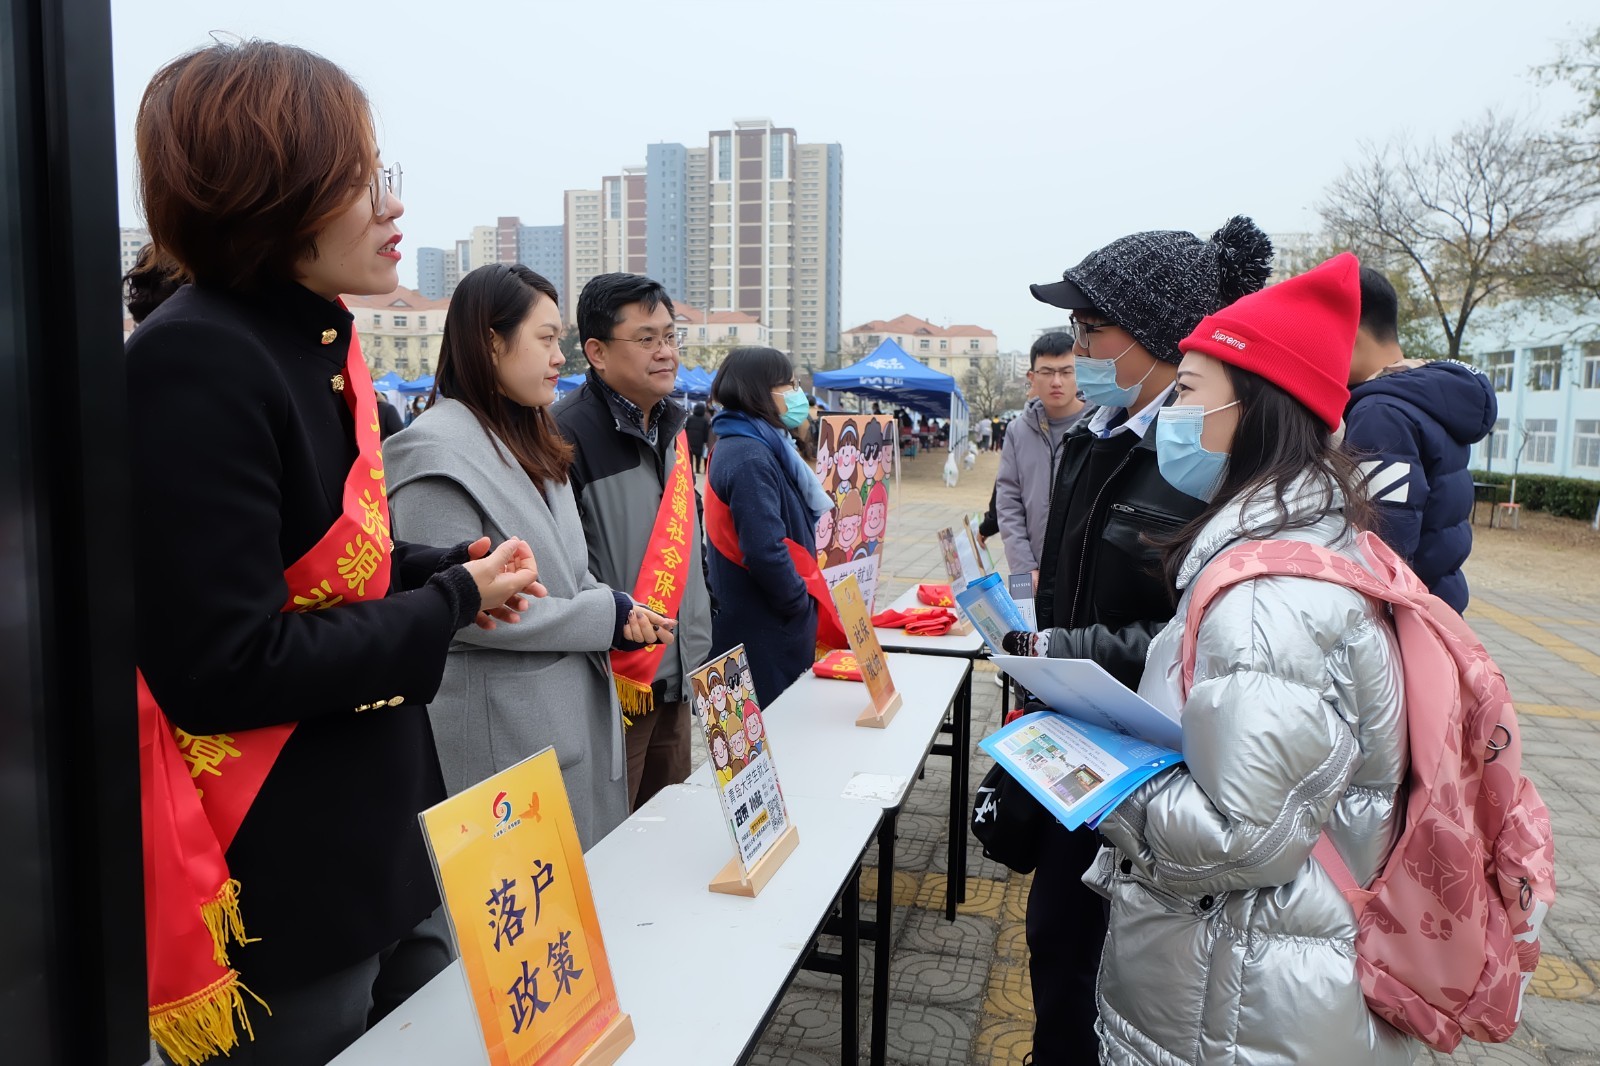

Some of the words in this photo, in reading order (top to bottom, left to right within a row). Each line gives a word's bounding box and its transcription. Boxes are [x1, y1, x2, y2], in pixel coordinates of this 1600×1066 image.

[1211, 330, 1246, 350] Supreme
[728, 758, 770, 804] 青岛大学生就业
[734, 802, 750, 828] 政策
[485, 859, 555, 952] 落户
[508, 930, 585, 1035] 政策
